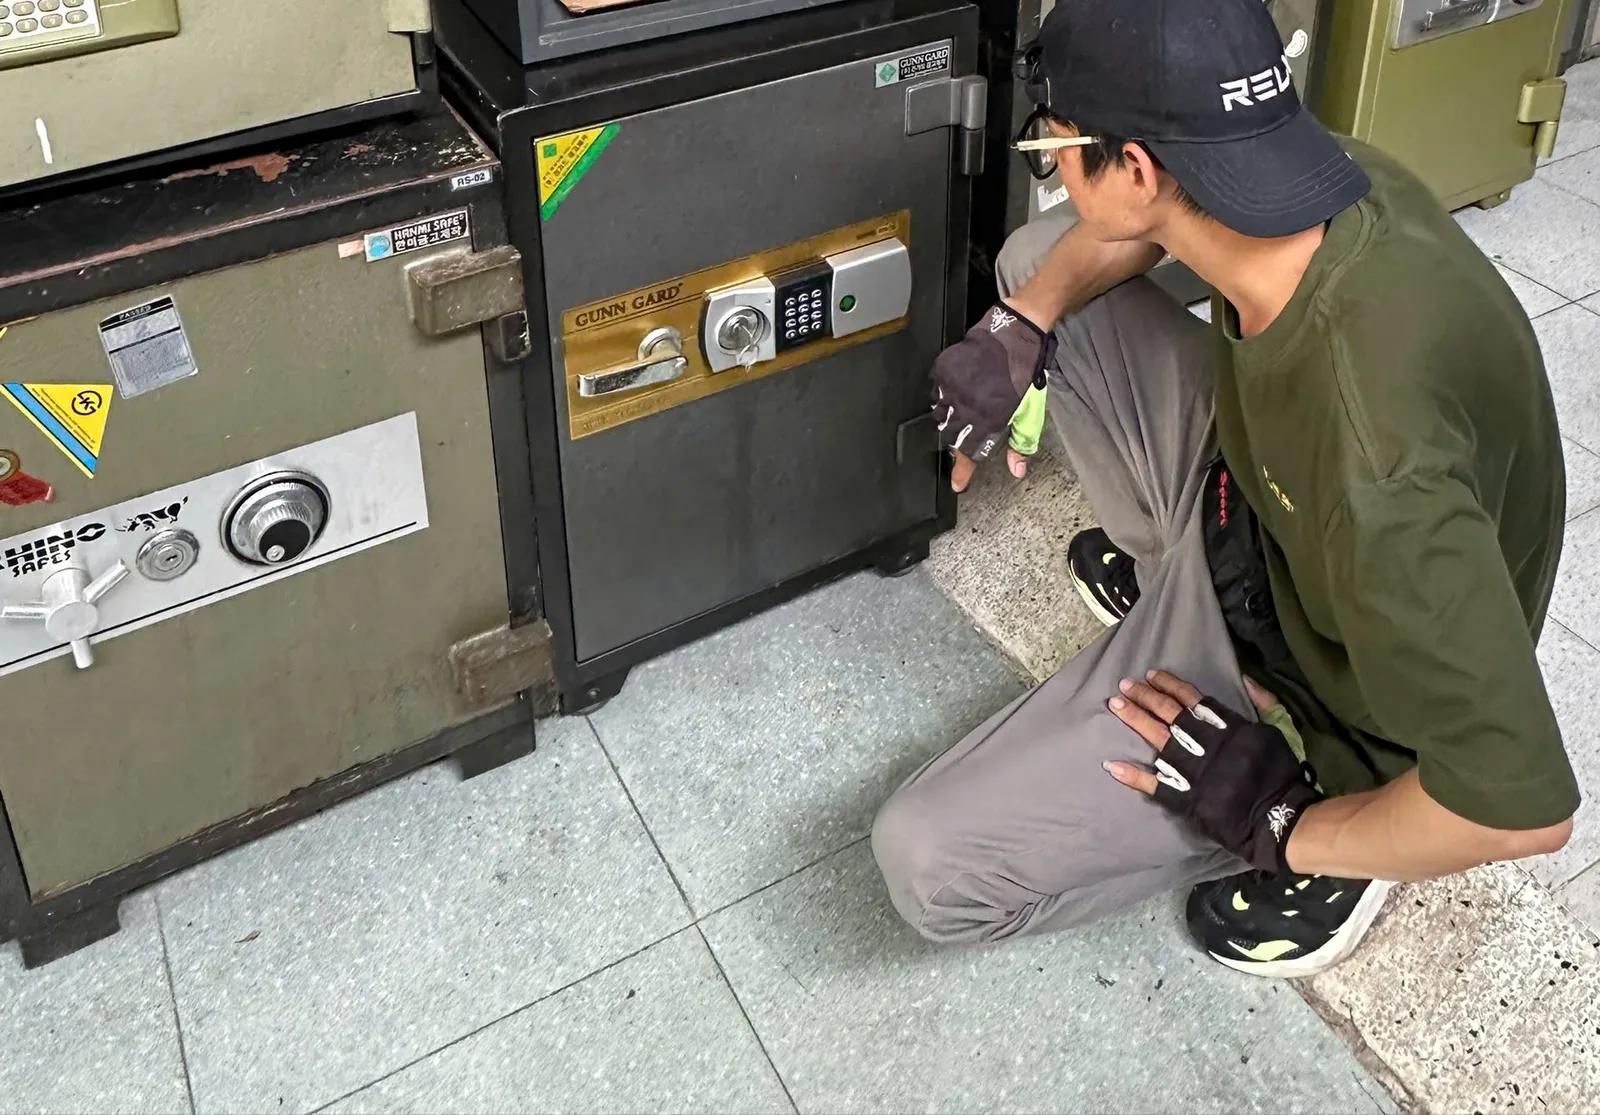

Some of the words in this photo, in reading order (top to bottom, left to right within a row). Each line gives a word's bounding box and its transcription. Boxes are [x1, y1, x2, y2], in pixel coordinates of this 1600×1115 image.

[900, 54, 925, 68] GUNN
[925, 49, 948, 62] GARD
[394, 222, 431, 240] HANMI
[395, 225, 462, 251] 한미금고제작
[575, 300, 627, 327] GUNN
[631, 285, 681, 310] GARD
[0, 523, 106, 570] HINO
[13, 550, 72, 578] SAFES
